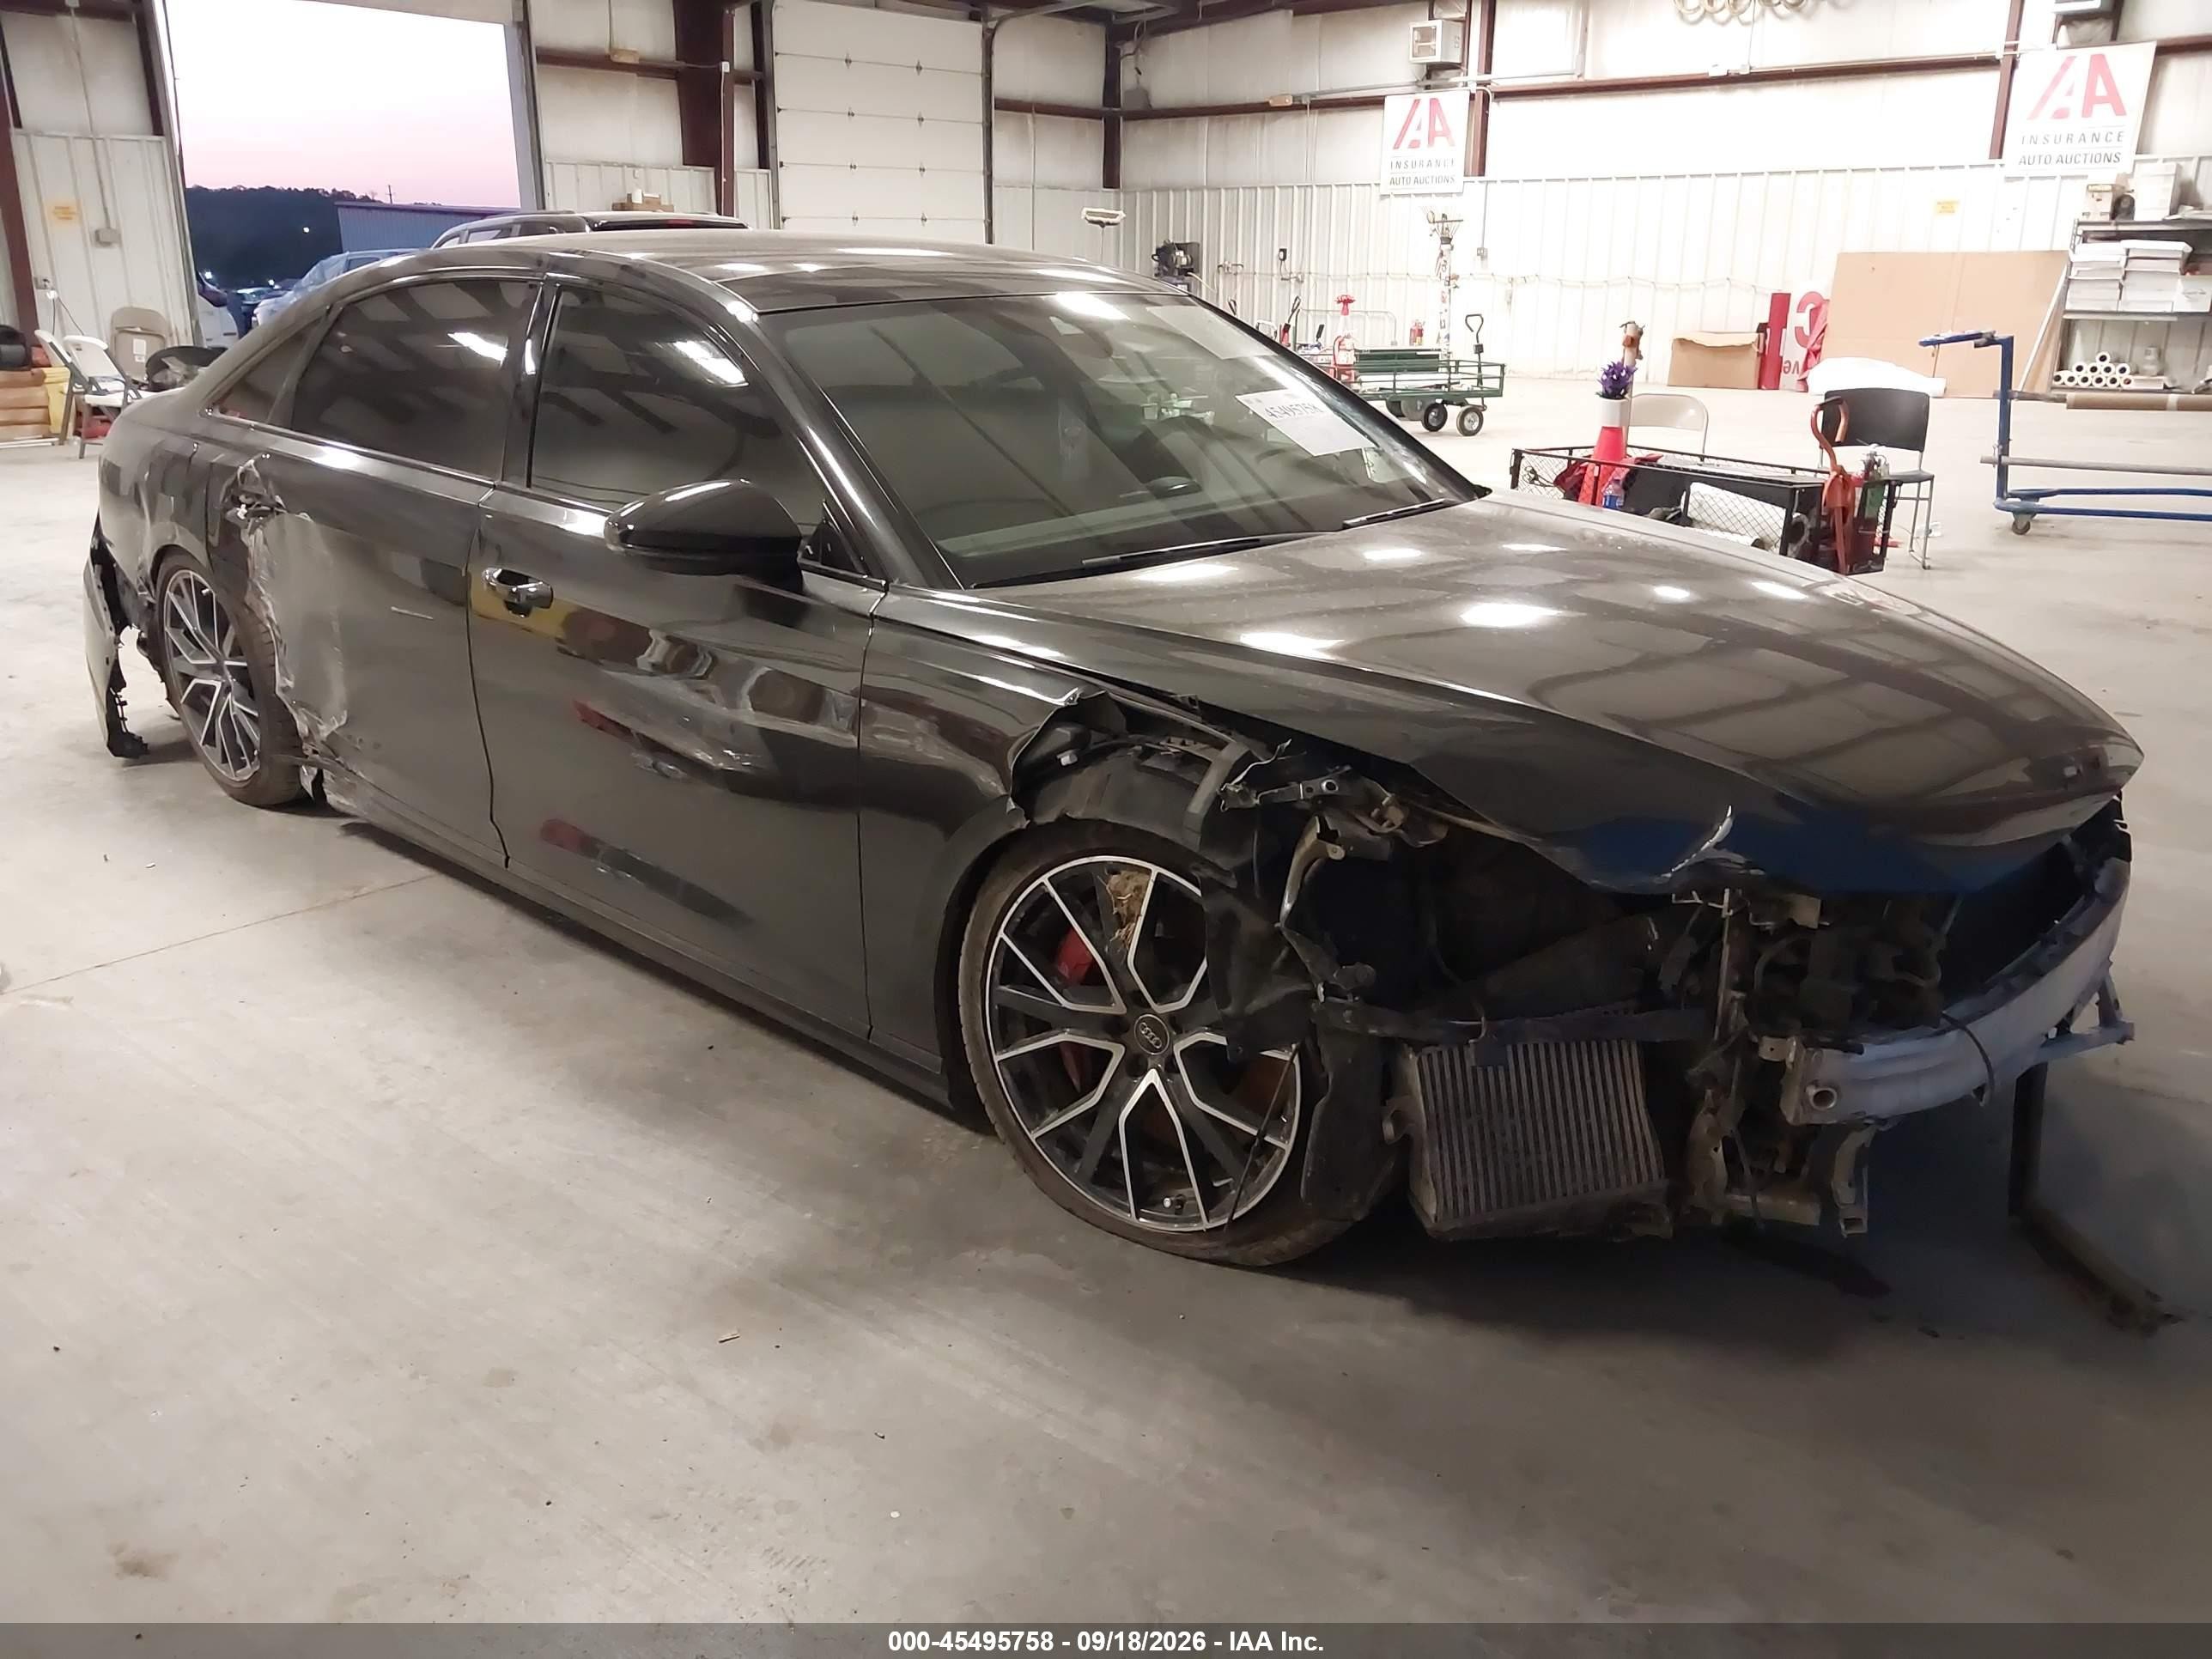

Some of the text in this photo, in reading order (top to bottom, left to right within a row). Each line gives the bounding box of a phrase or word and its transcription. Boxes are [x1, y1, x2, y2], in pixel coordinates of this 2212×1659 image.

[2021, 131, 2124, 145] INSURANCE
[2018, 152, 2122, 166] AUTO AUCTIONS
[1389, 174, 1455, 186] AUTO AUCTIONS
